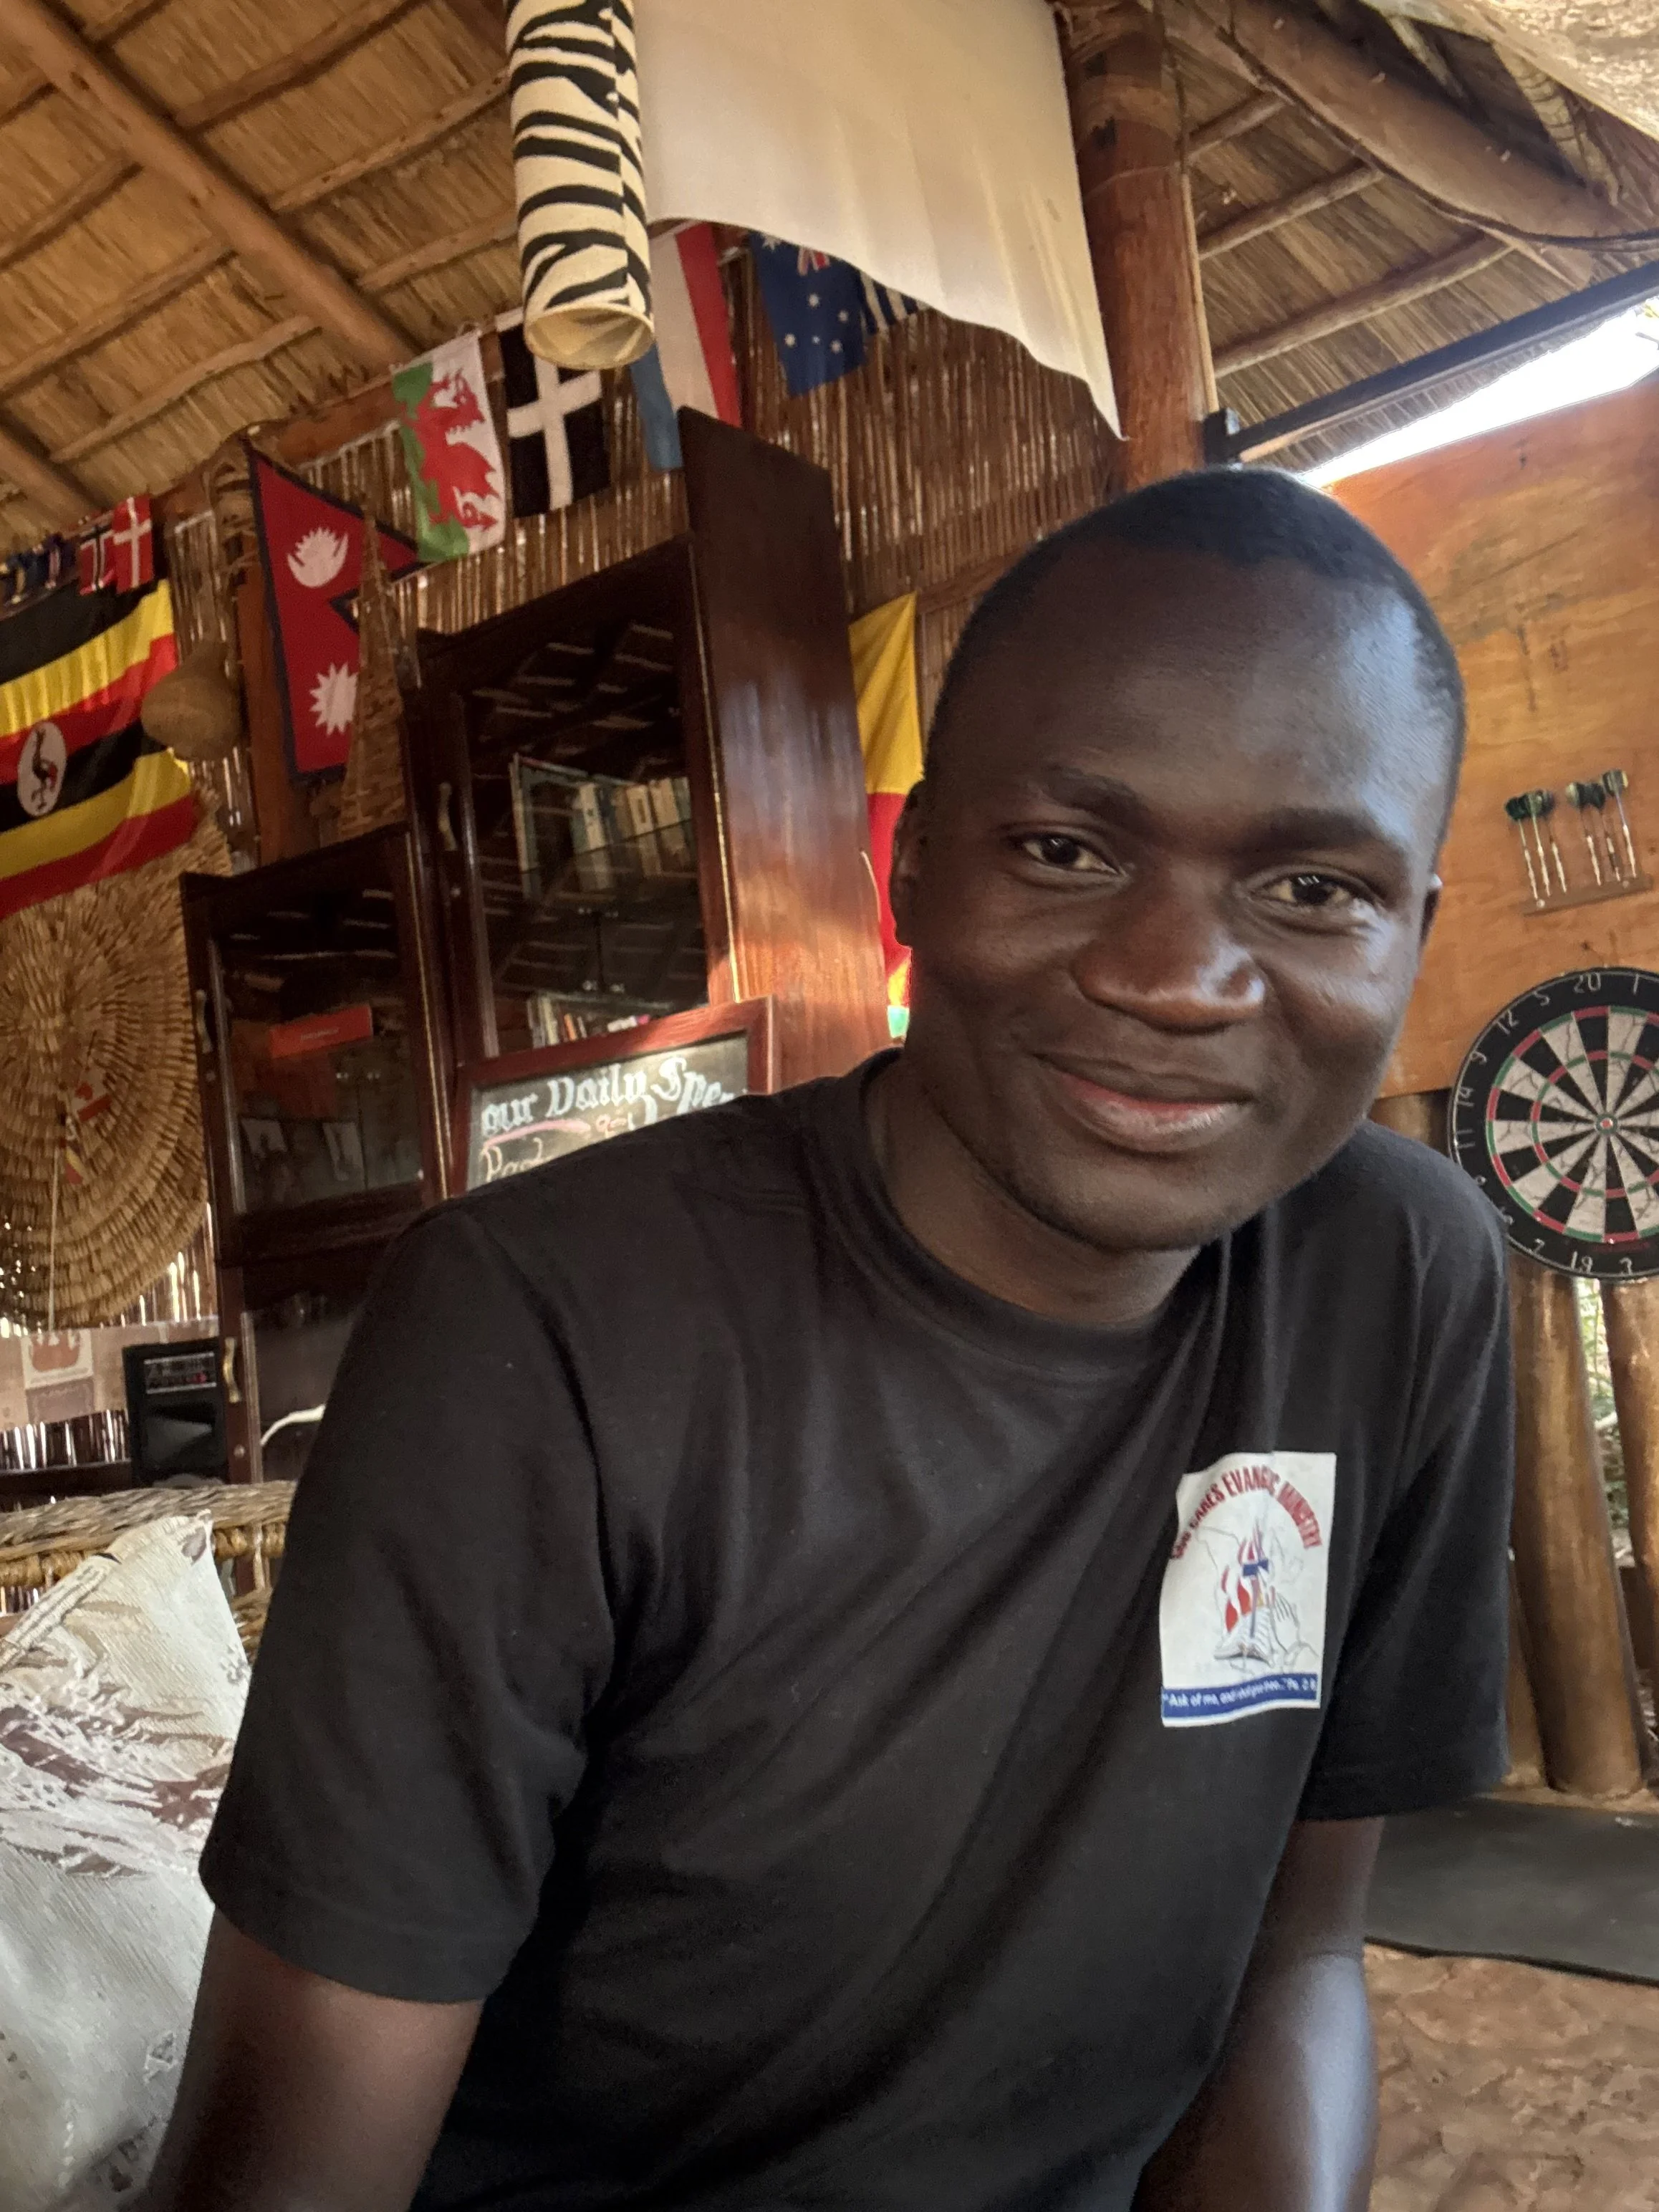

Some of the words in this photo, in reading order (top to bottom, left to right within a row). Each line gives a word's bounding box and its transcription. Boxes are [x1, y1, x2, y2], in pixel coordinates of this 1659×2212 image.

[1573, 972, 1602, 994] 20
[1496, 1009, 1519, 1035] 12
[544, 1063, 658, 1125] Daily
